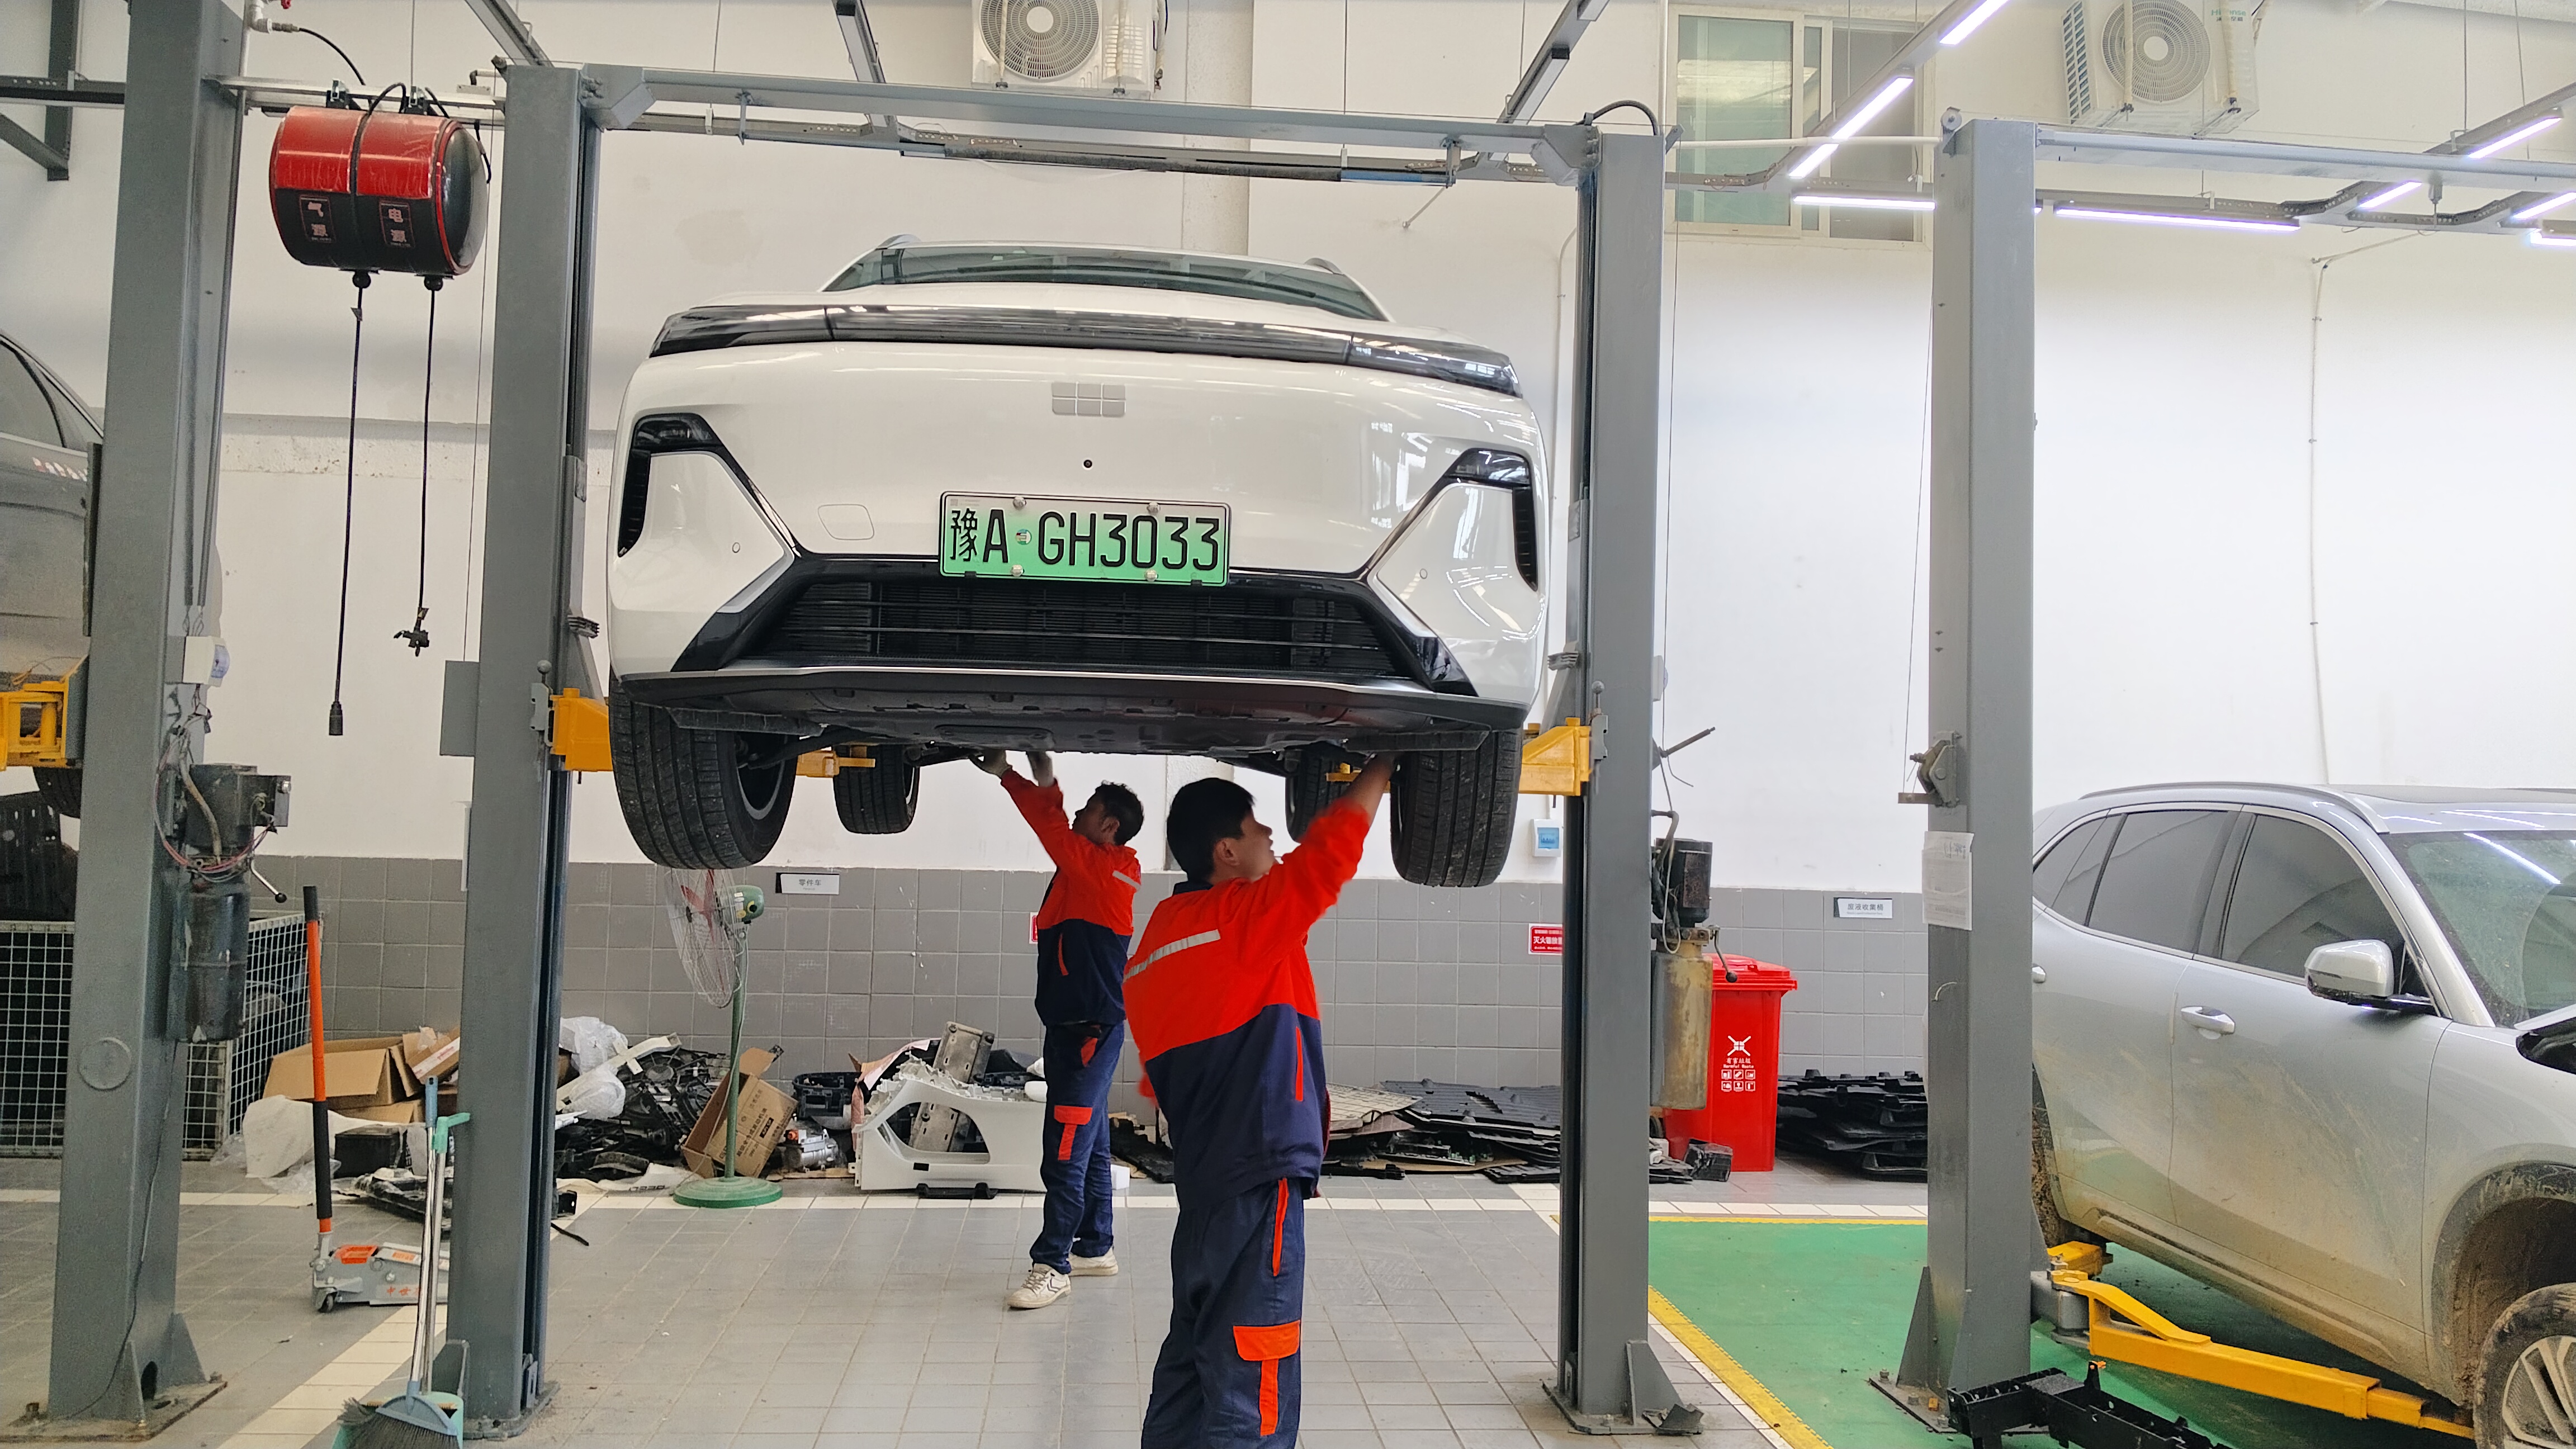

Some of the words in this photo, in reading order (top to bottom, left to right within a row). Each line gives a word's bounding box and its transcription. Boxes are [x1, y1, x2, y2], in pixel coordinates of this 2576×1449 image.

[307, 201, 329, 237] 气源
[388, 208, 407, 243] 电源
[950, 508, 1008, 564] 豫A
[1038, 511, 1220, 571] GH3033
